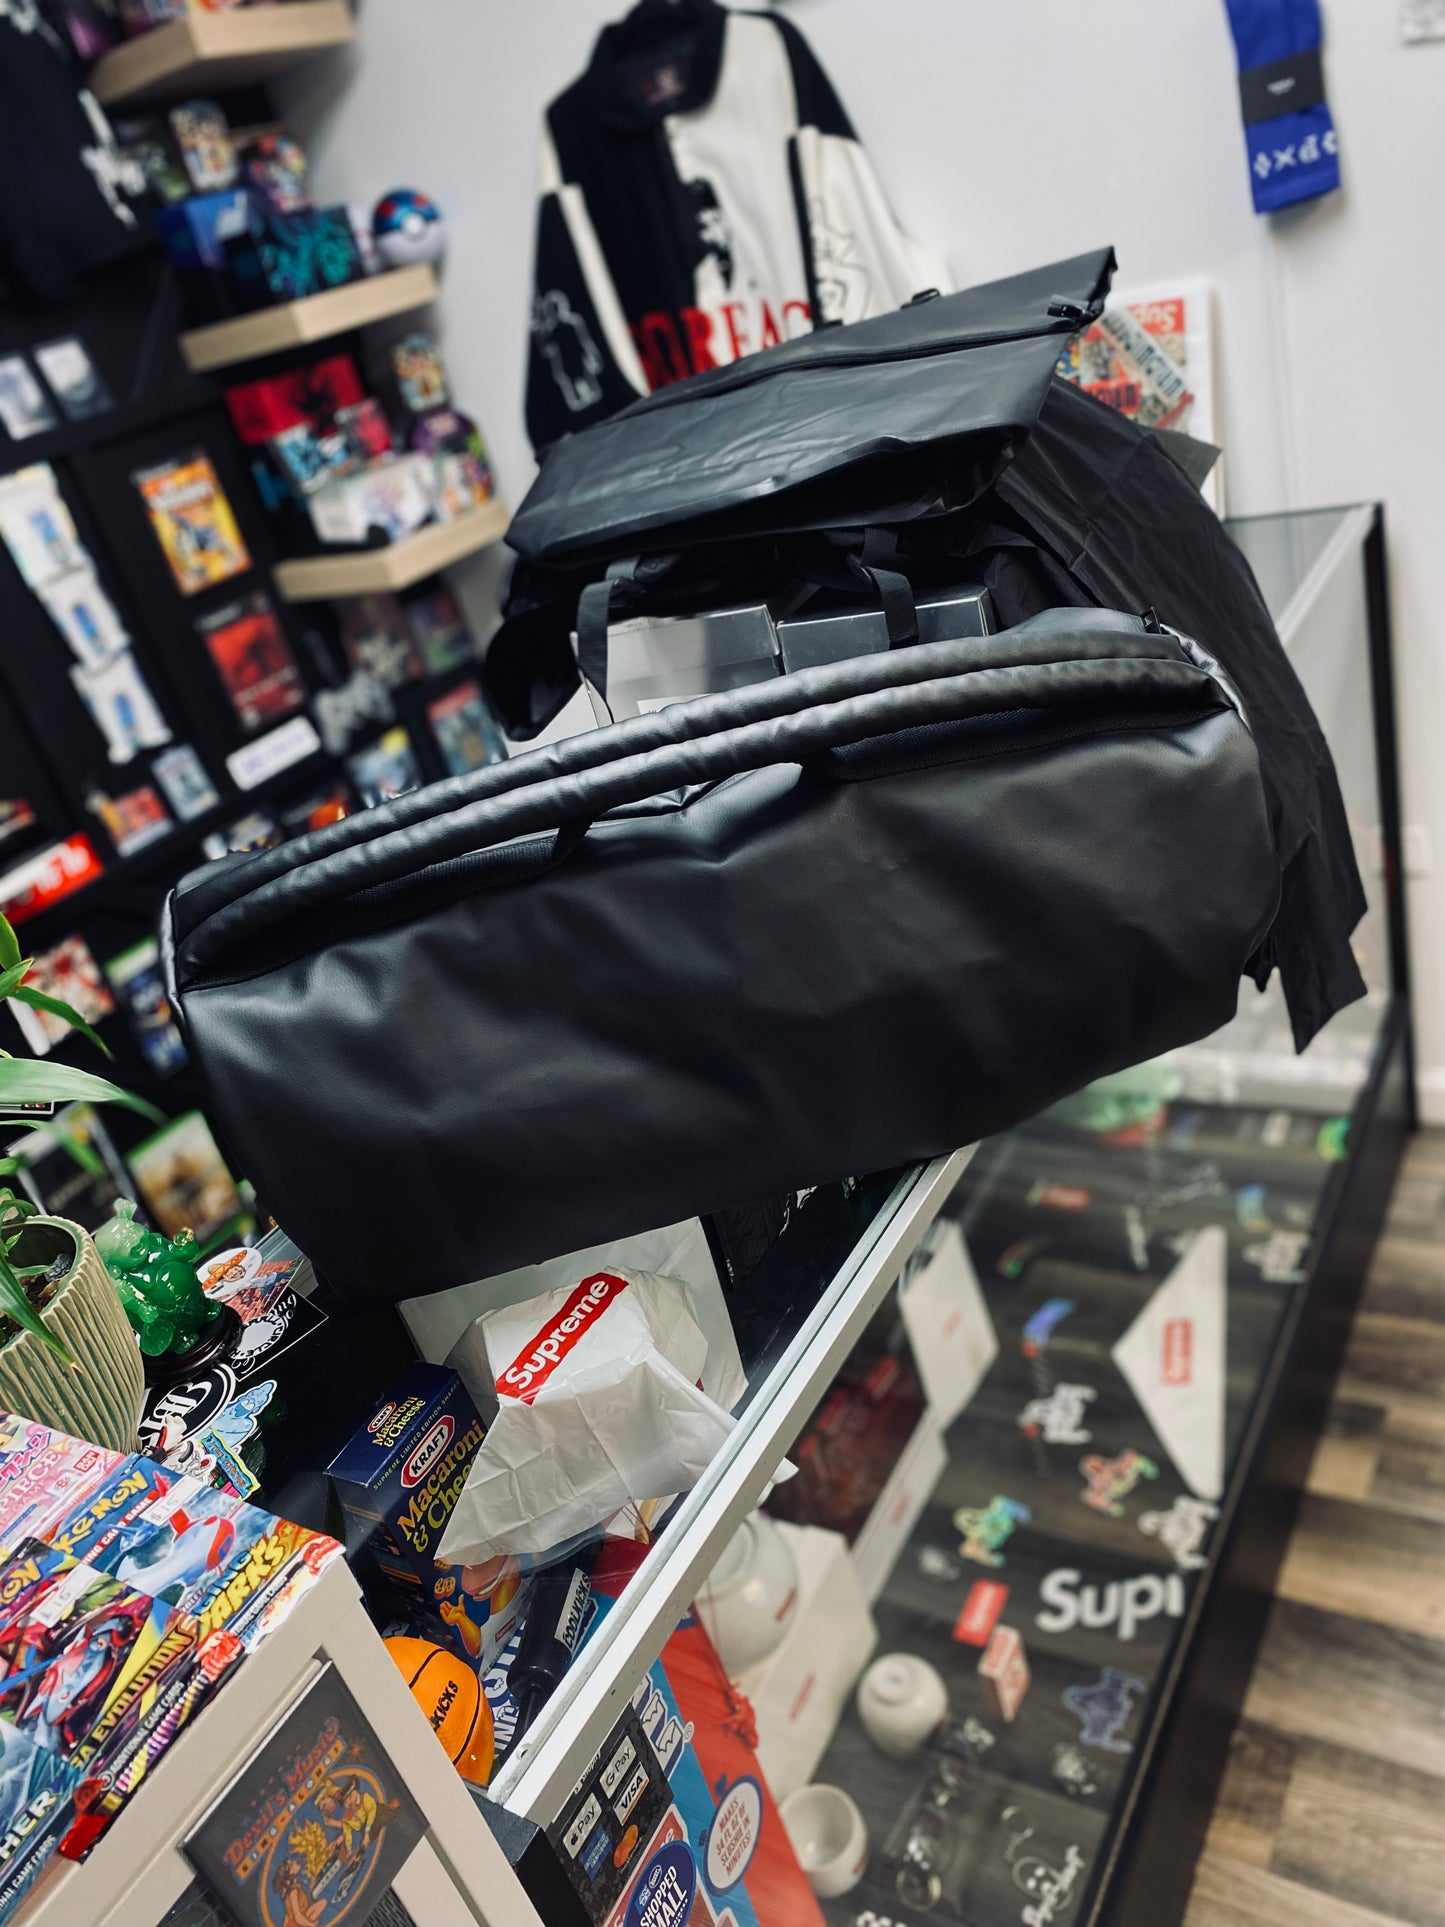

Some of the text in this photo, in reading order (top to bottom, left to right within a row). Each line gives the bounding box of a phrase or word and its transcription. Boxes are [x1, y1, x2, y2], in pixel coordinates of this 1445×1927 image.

[505, 1280, 610, 1390] Supreme
[372, 1408, 391, 1428] KRAFT
[372, 1396, 420, 1446] Macaroni
[384, 1400, 427, 1449] & Cheese
[373, 1458, 401, 1491] SUPREME
[400, 1431, 423, 1459] LIMITED
[421, 1405, 443, 1433] EDITION
[411, 1427, 446, 1476] KRAFT
[396, 1420, 486, 1542] Macaroni
[413, 1524, 429, 1553] &
[562, 1573, 591, 1649] COOLKICKS
[92, 1631, 195, 1743] EVOLUTION
[110, 1681, 185, 1774] ADDITIONAL GAME CARDS
[614, 1747, 631, 1773] Pay
[620, 1775, 644, 1810] VISA
[718, 1796, 739, 1833] MAKES
[223, 1792, 287, 1865] Devil's
[577, 1805, 596, 1834] Pay
[12, 1861, 34, 1888] GAME
[640, 1865, 677, 1927] SHOPPED
